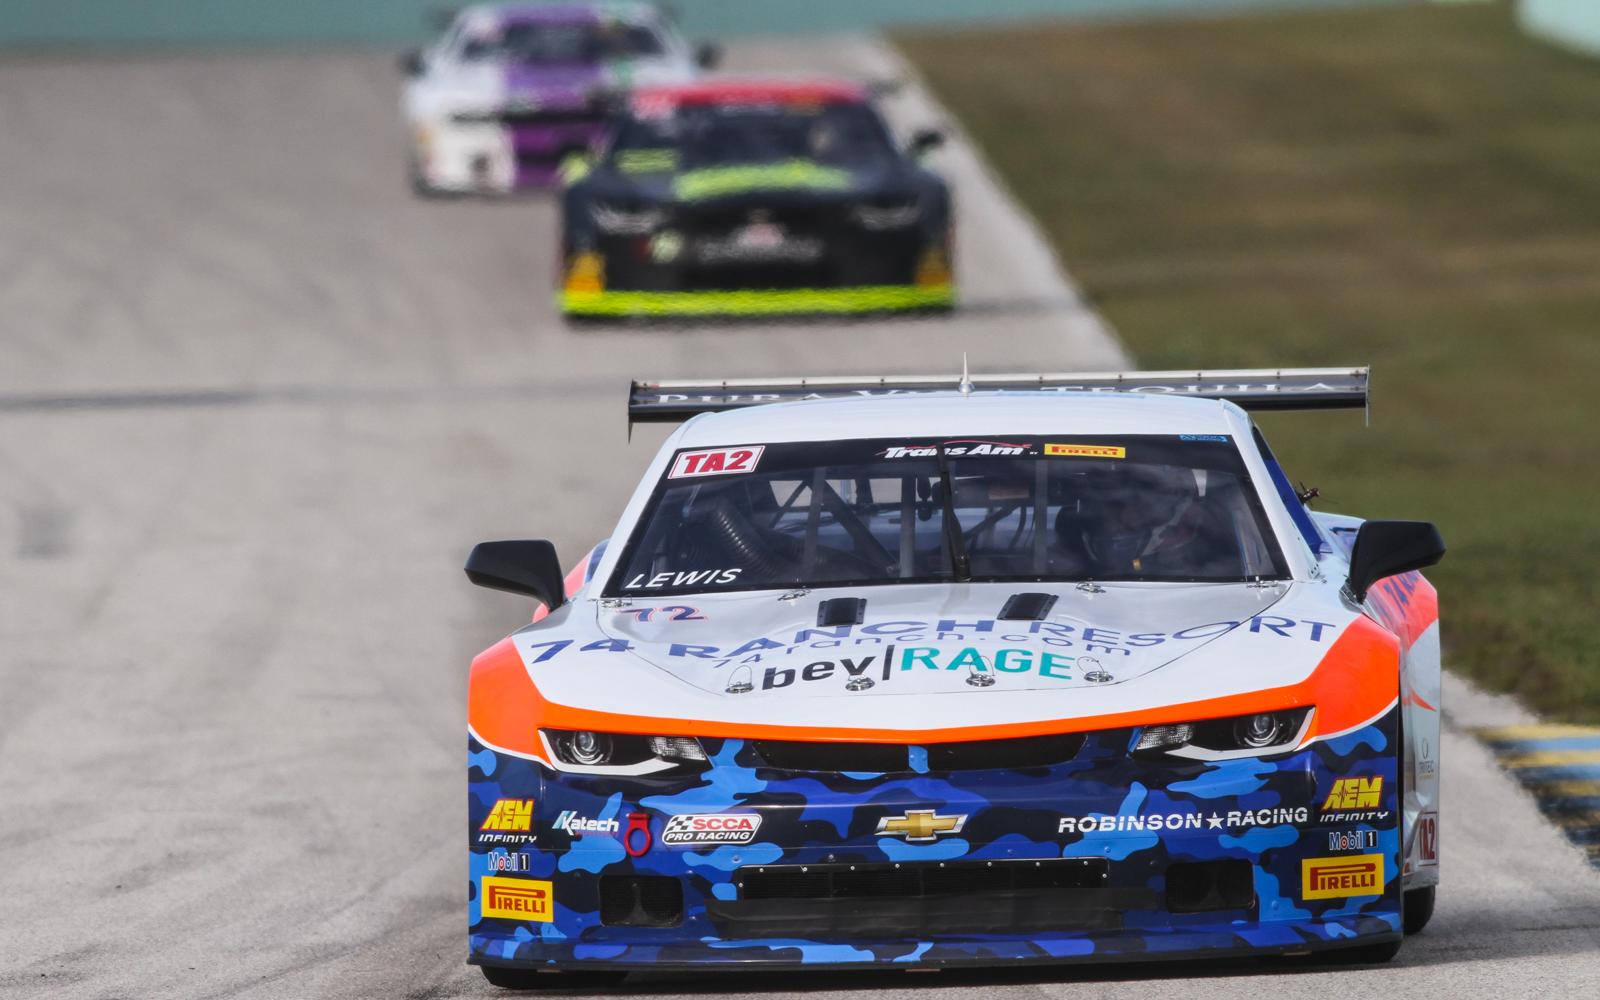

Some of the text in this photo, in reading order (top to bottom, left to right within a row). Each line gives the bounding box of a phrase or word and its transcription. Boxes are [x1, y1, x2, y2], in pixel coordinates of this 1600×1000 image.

[967, 444, 1024, 455] Am
[683, 449, 754, 474] TA2
[625, 568, 743, 589] LEWIS
[619, 604, 710, 623] 72
[531, 615, 1337, 664] 74 RANCH RESORT
[1321, 776, 1384, 811] AEM
[552, 810, 620, 836] Katech
[692, 818, 753, 831] SCCA
[1058, 807, 1308, 833] ROBINSON RACING
[1319, 811, 1389, 823] INFINITY
[478, 833, 537, 844] INFINITY
[666, 831, 750, 842] PRO RACING
[1329, 830, 1378, 850] Mobil 1
[488, 852, 530, 871] Mobil 1
[1310, 863, 1376, 891] PIRELLI
[488, 885, 546, 914] PIRELLI
